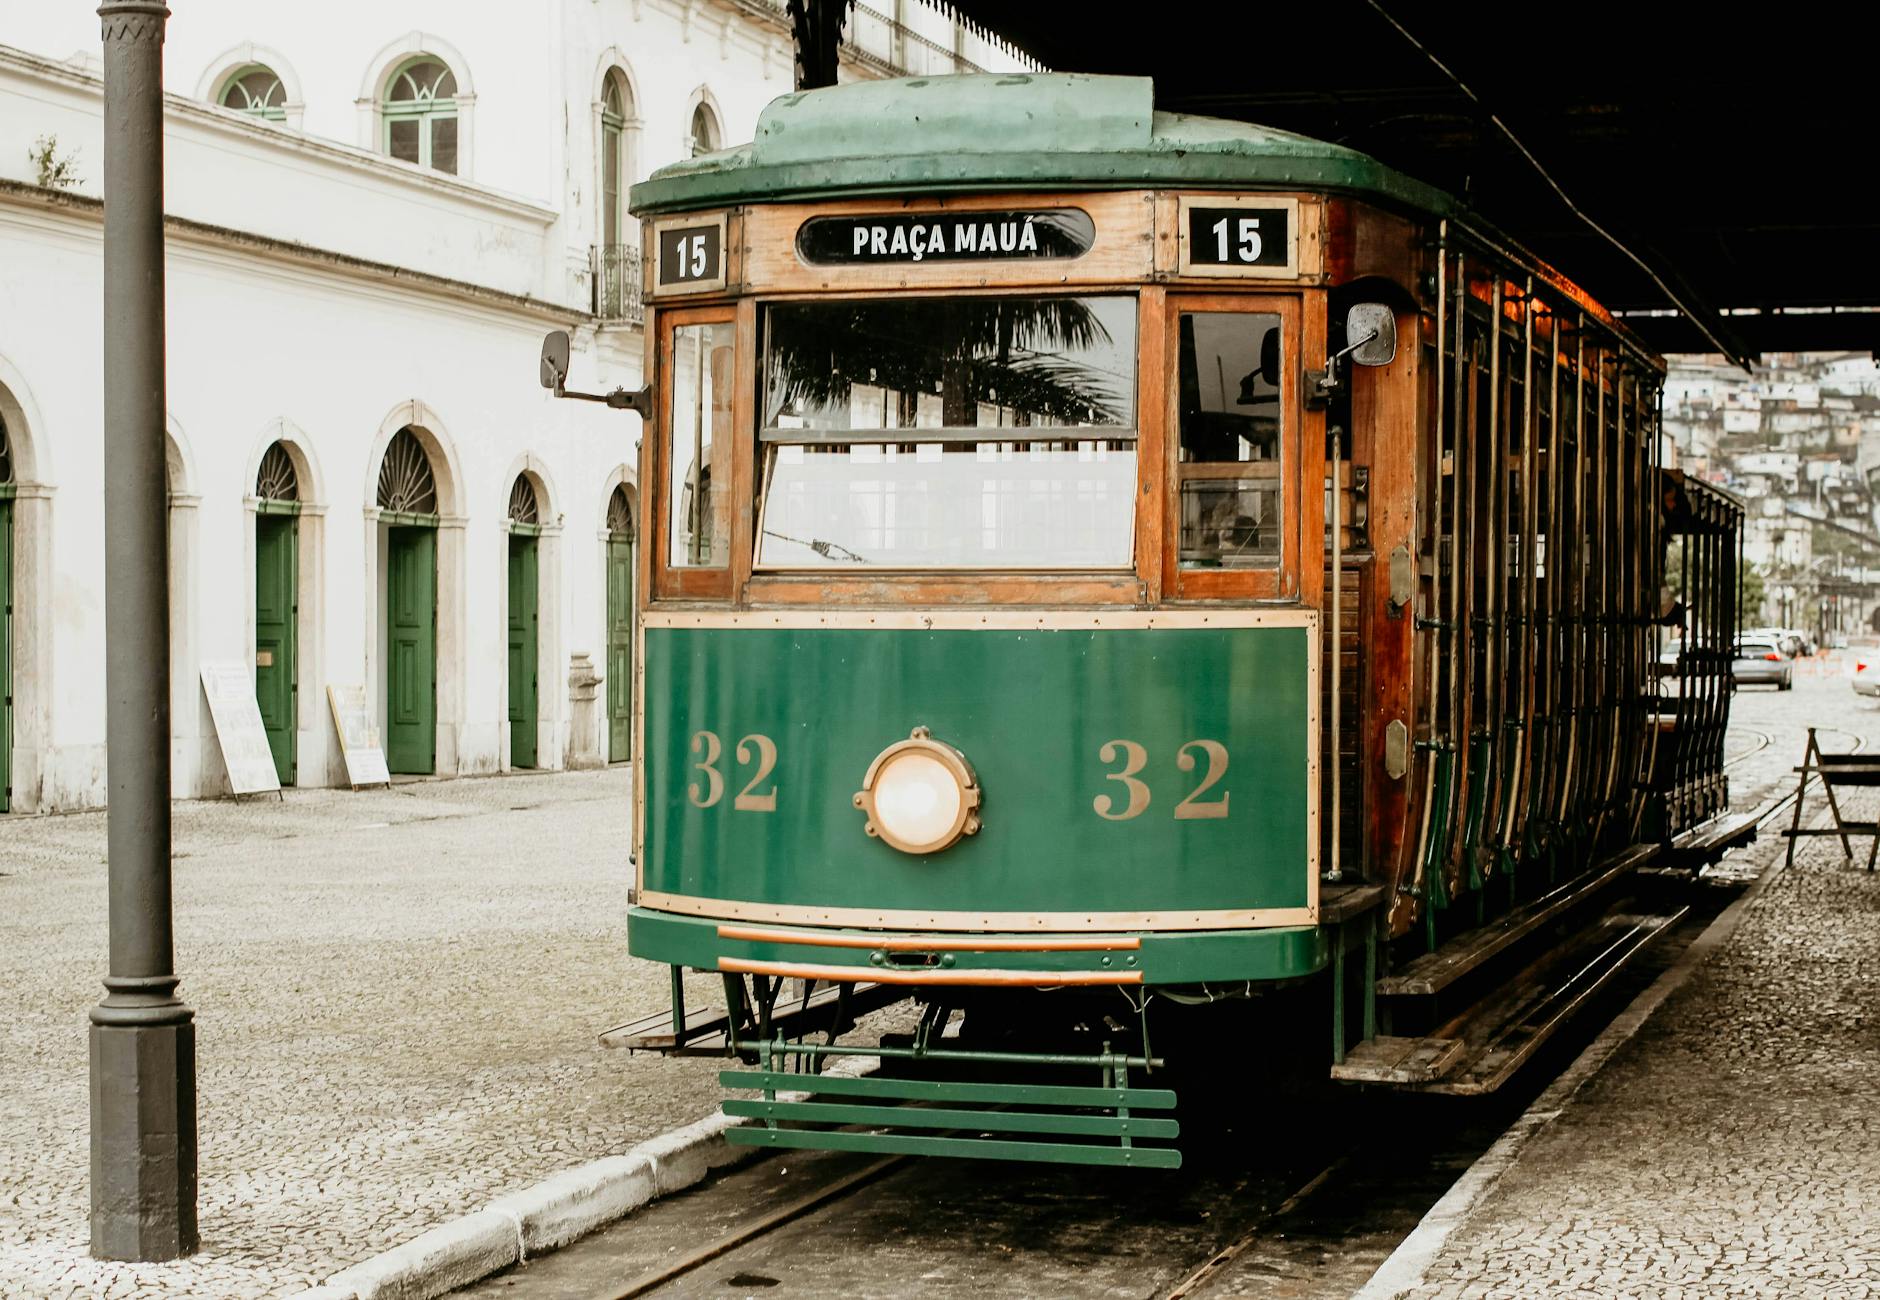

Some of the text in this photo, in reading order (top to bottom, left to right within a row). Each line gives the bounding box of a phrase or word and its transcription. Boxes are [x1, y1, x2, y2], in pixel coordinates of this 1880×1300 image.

[675, 236, 707, 277] 15
[853, 216, 1038, 260] PRAÇA MAUÁ
[1213, 218, 1262, 261] 15
[688, 731, 777, 811] 32
[1093, 740, 1229, 820] 32
